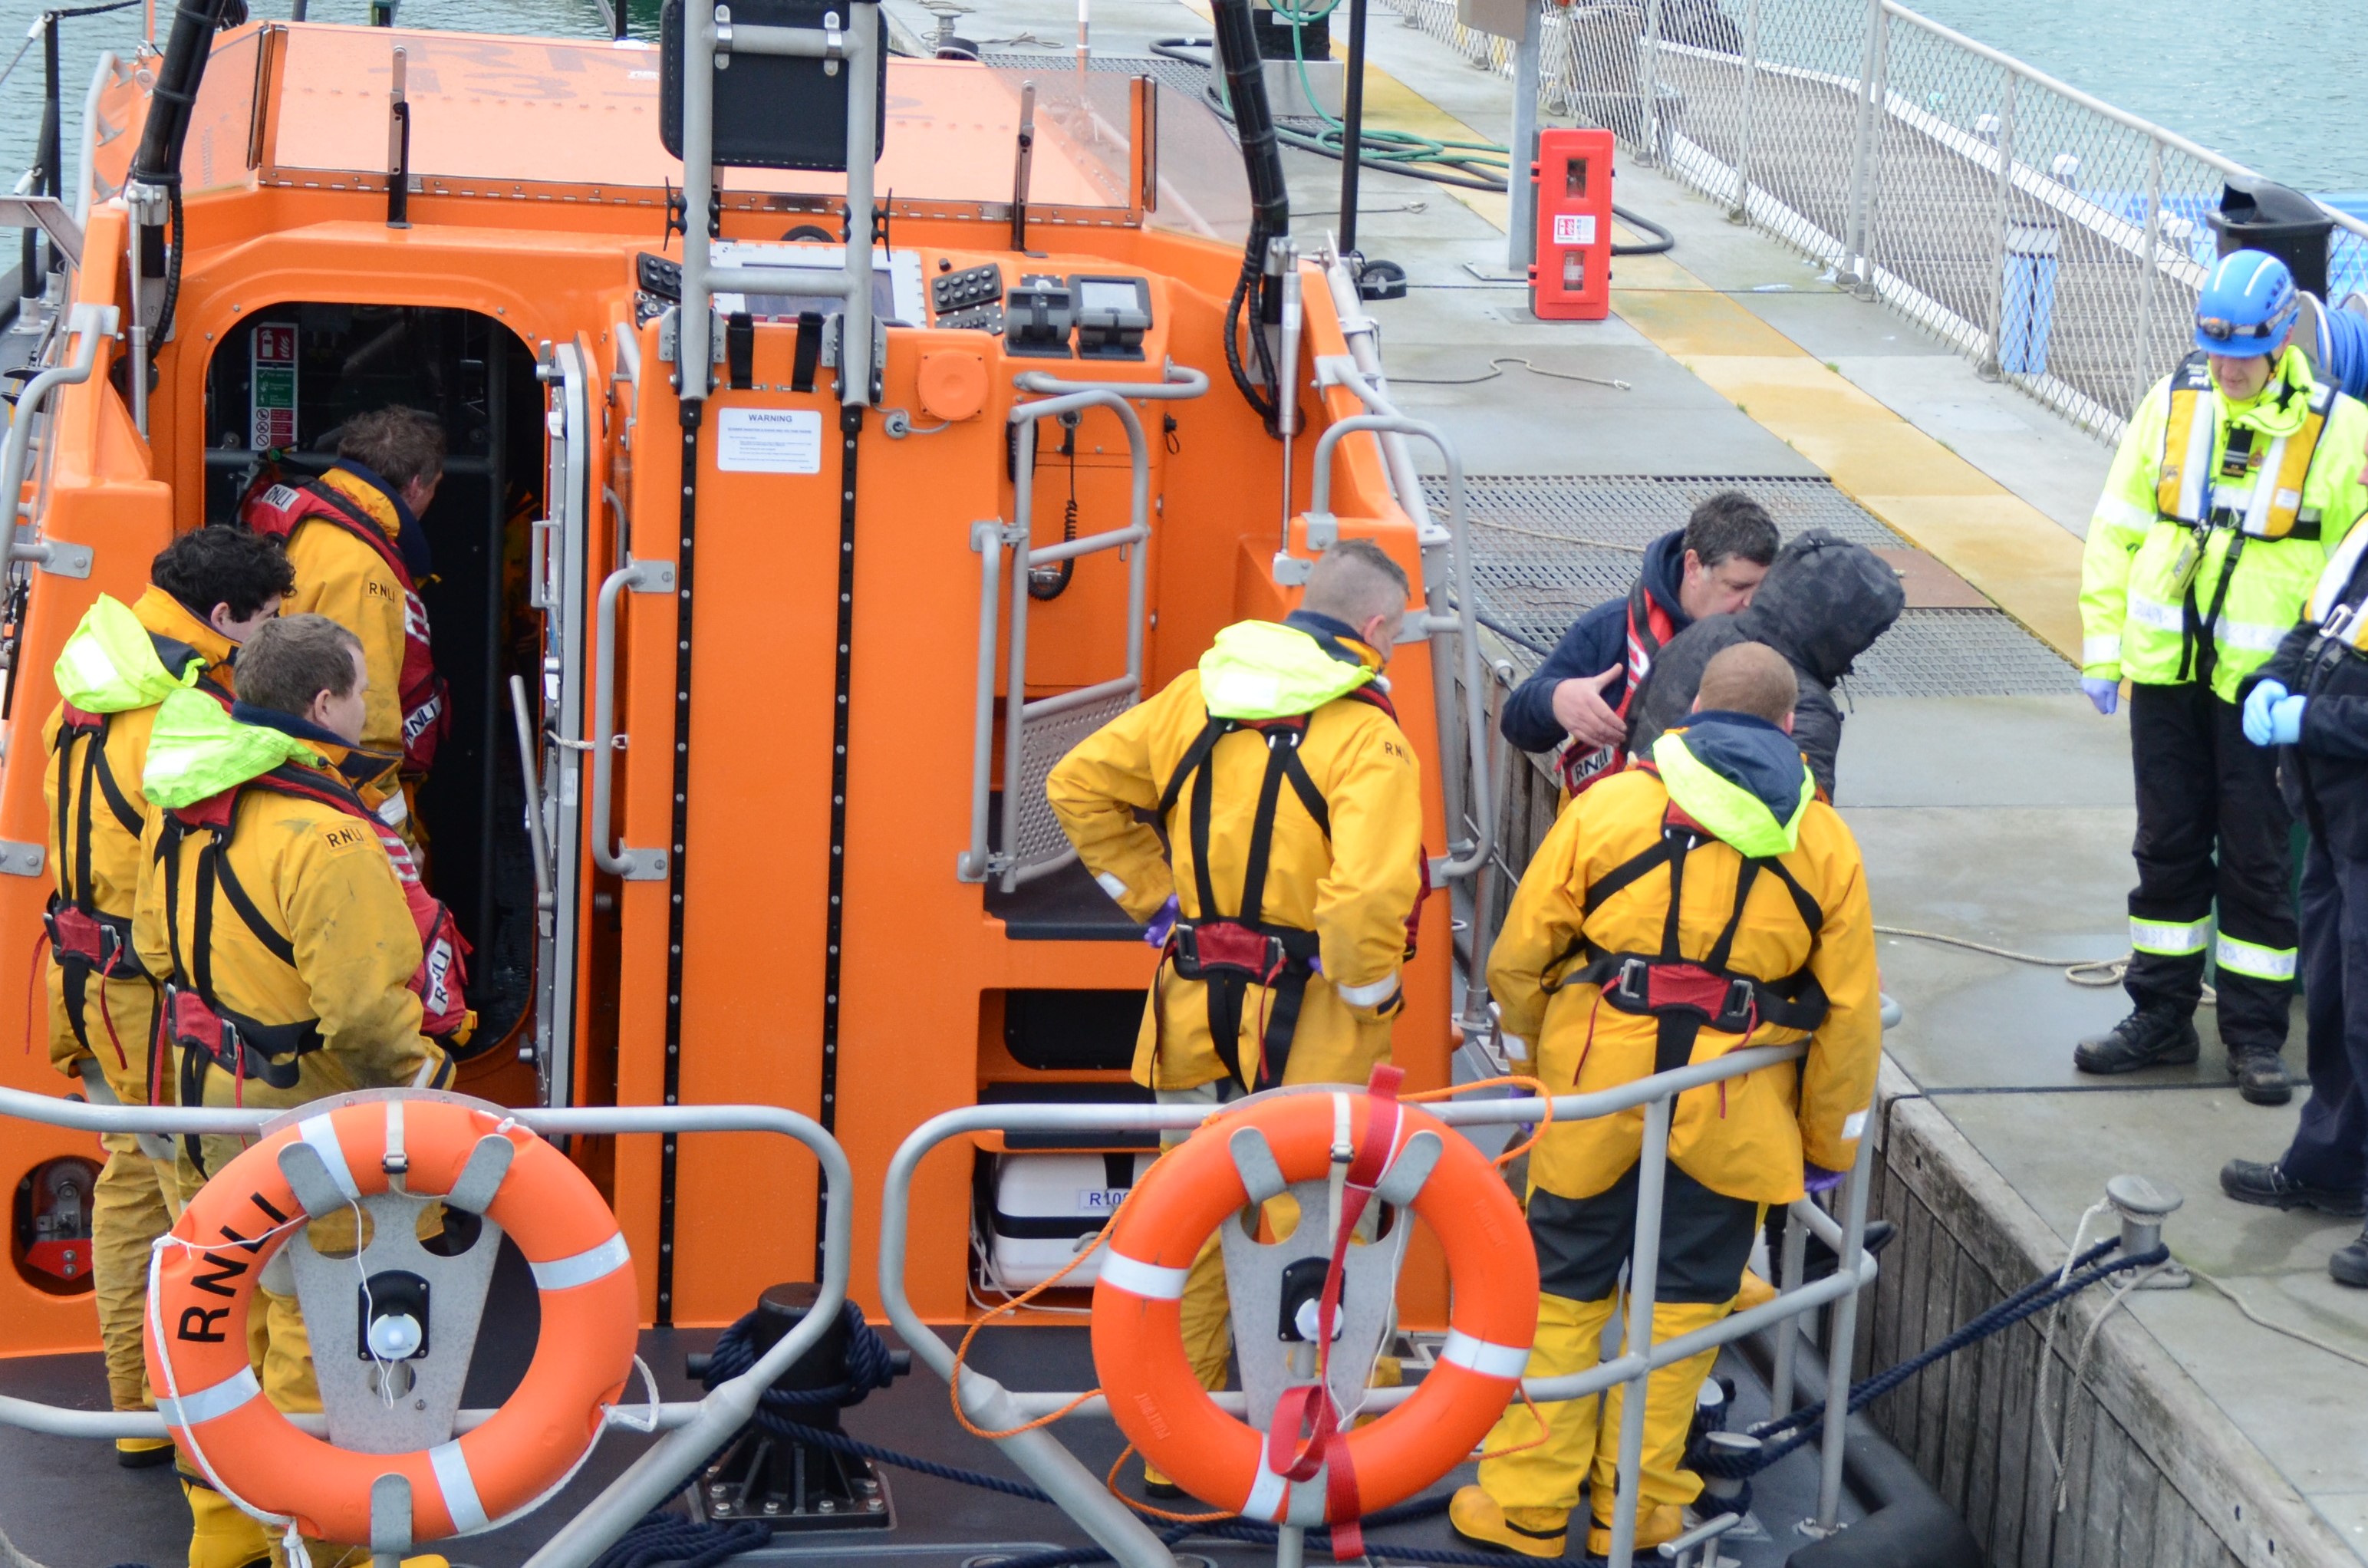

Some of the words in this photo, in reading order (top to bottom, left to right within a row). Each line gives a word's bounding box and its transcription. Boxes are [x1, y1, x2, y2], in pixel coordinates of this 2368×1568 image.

[749, 413, 792, 423] WARNING
[265, 486, 293, 508] RNLI
[369, 581, 395, 603] RNLI
[404, 703, 438, 743] RNLI
[1575, 748, 1609, 781] RNLI
[326, 828, 364, 847] RNLI
[177, 1191, 289, 1342] RNLI
